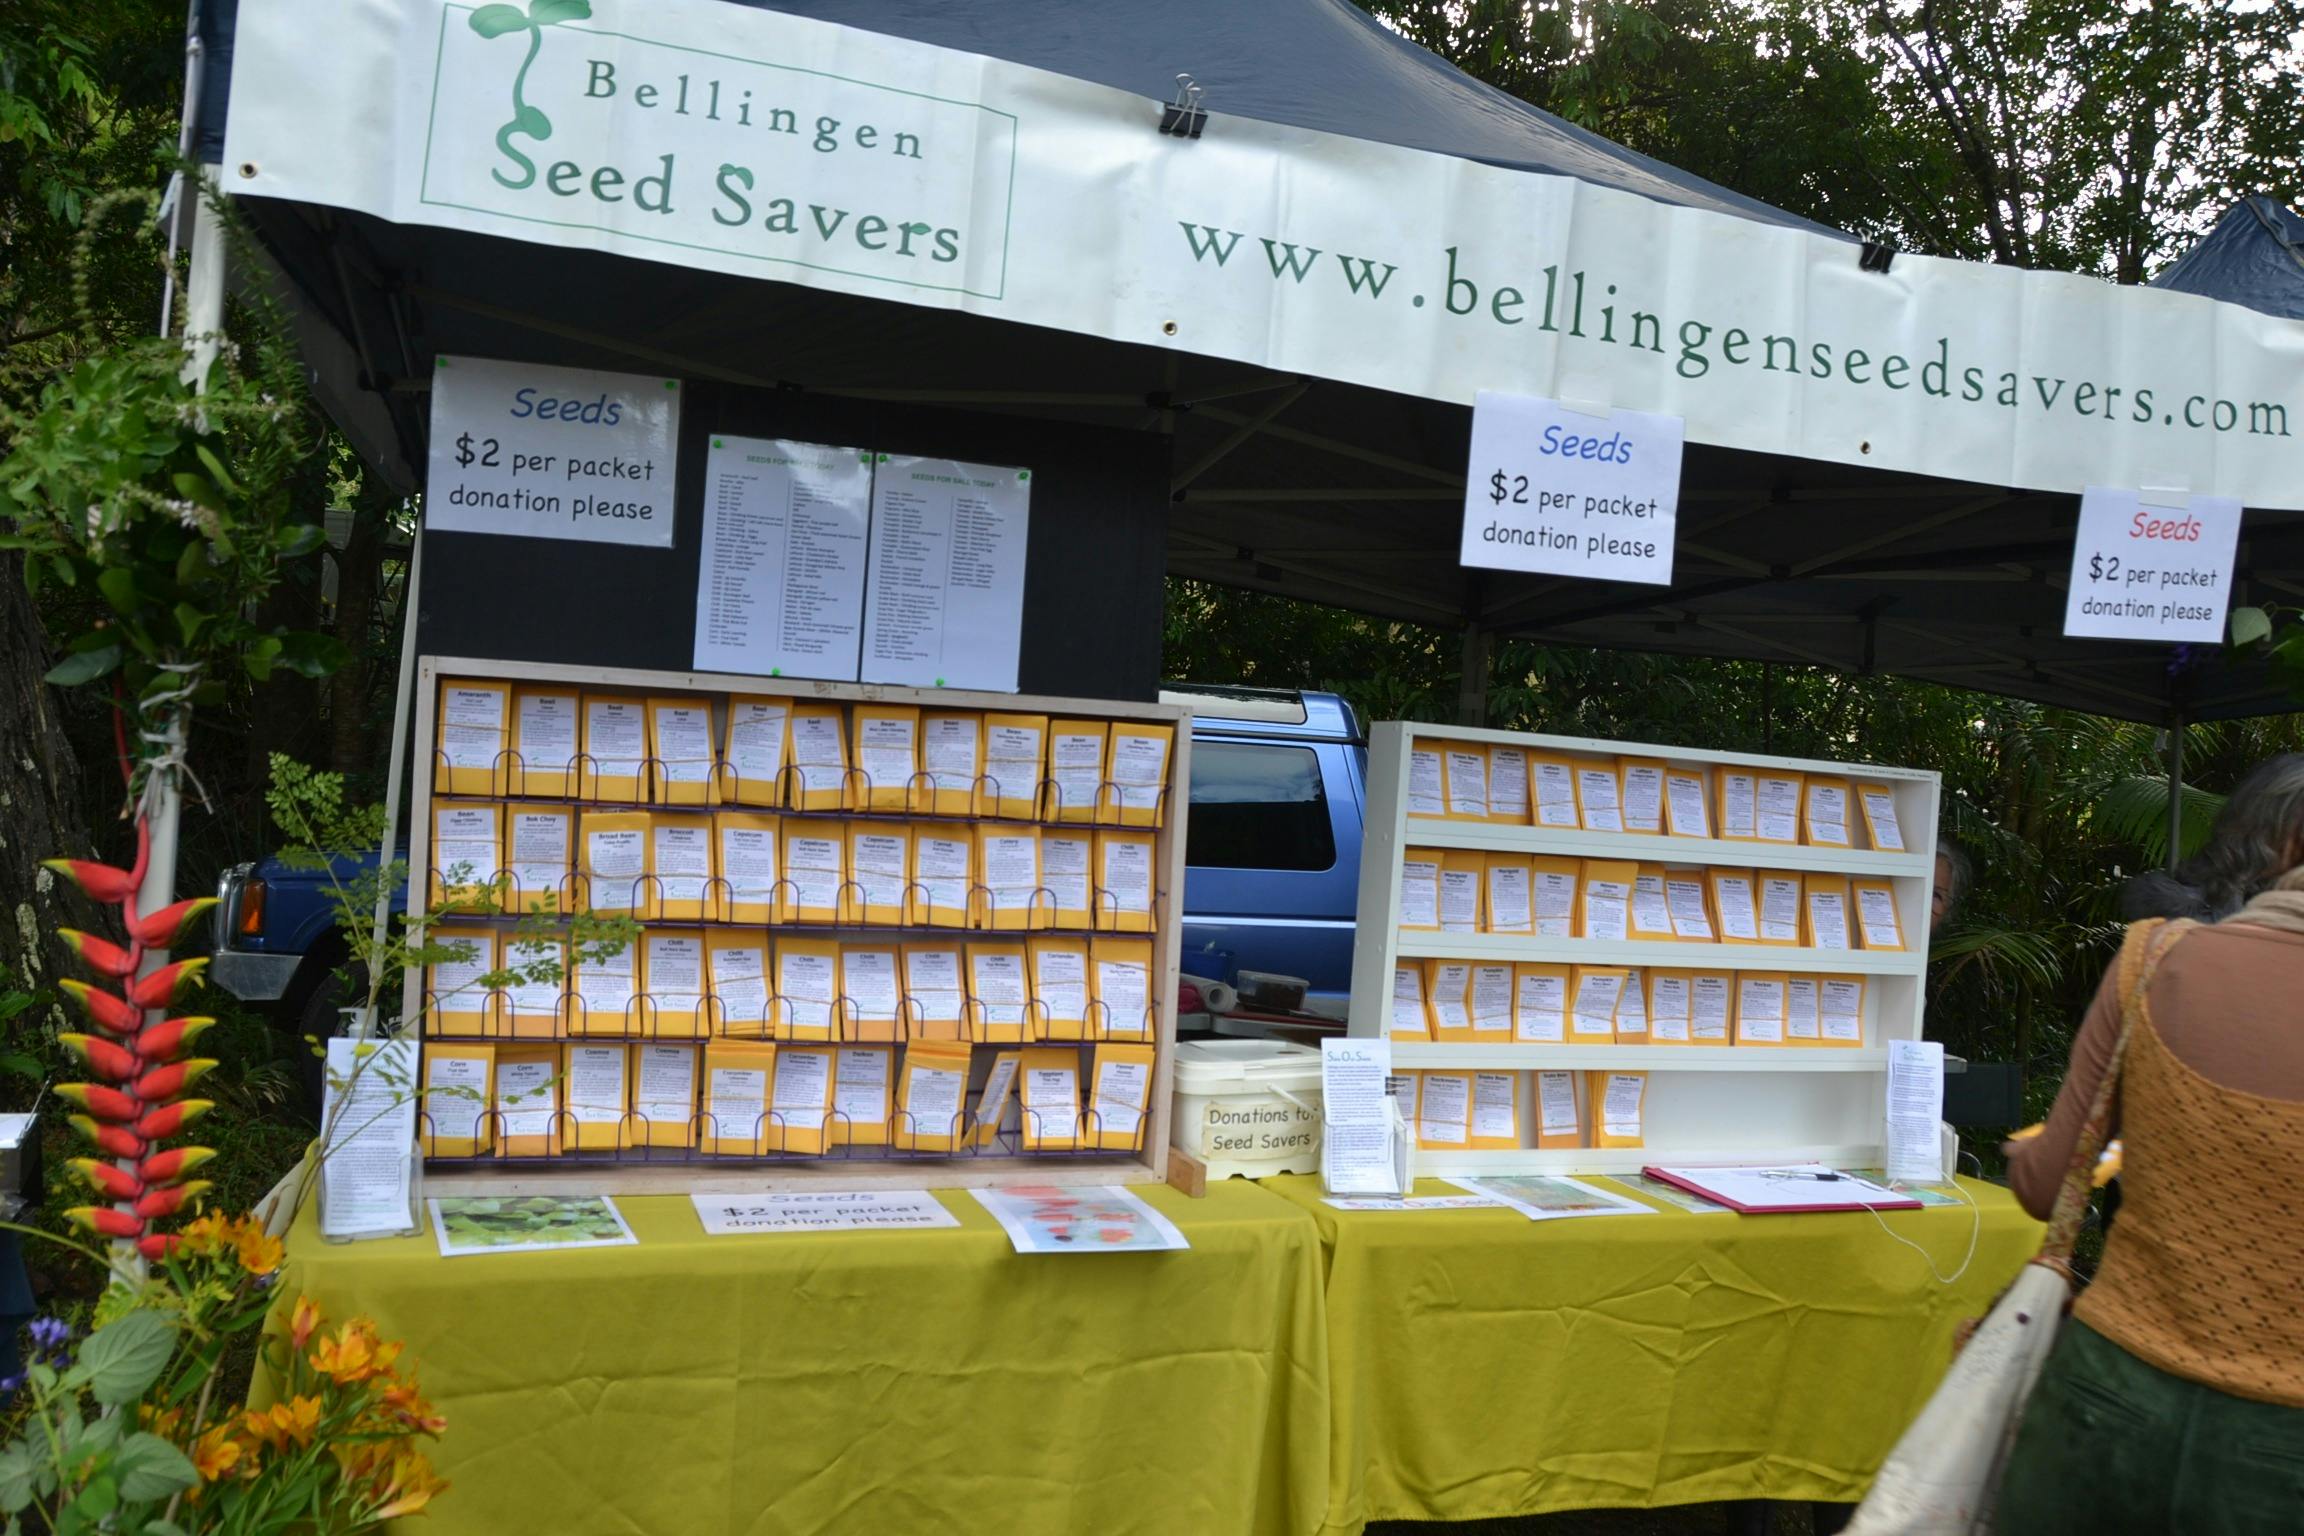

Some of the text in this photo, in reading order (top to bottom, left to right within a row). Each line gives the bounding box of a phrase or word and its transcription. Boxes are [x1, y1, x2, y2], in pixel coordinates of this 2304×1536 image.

[585, 60, 924, 159] Bellingen
[492, 119, 960, 264] Seed Savers
[1178, 220, 2292, 437] www.bellingenseedsavers.com
[510, 387, 623, 426] Seeds
[455, 432, 654, 480] $2 per packet
[1539, 425, 1633, 464] Seeds
[449, 484, 653, 521] donation please
[1489, 468, 1658, 519] $2 per packet
[1482, 520, 1655, 559] donation please
[2129, 512, 2202, 542] Seeds
[2088, 552, 2218, 590] $2 per packet
[2082, 596, 2213, 623] donation please
[450, 1060, 467, 1068] Corn
[1209, 1107, 1288, 1125] Donations
[1212, 1134, 1311, 1150] Seed Savers
[722, 1205, 923, 1217] $2 per packet
[768, 1193, 875, 1204] Seeds
[726, 1215, 934, 1229] donation please
